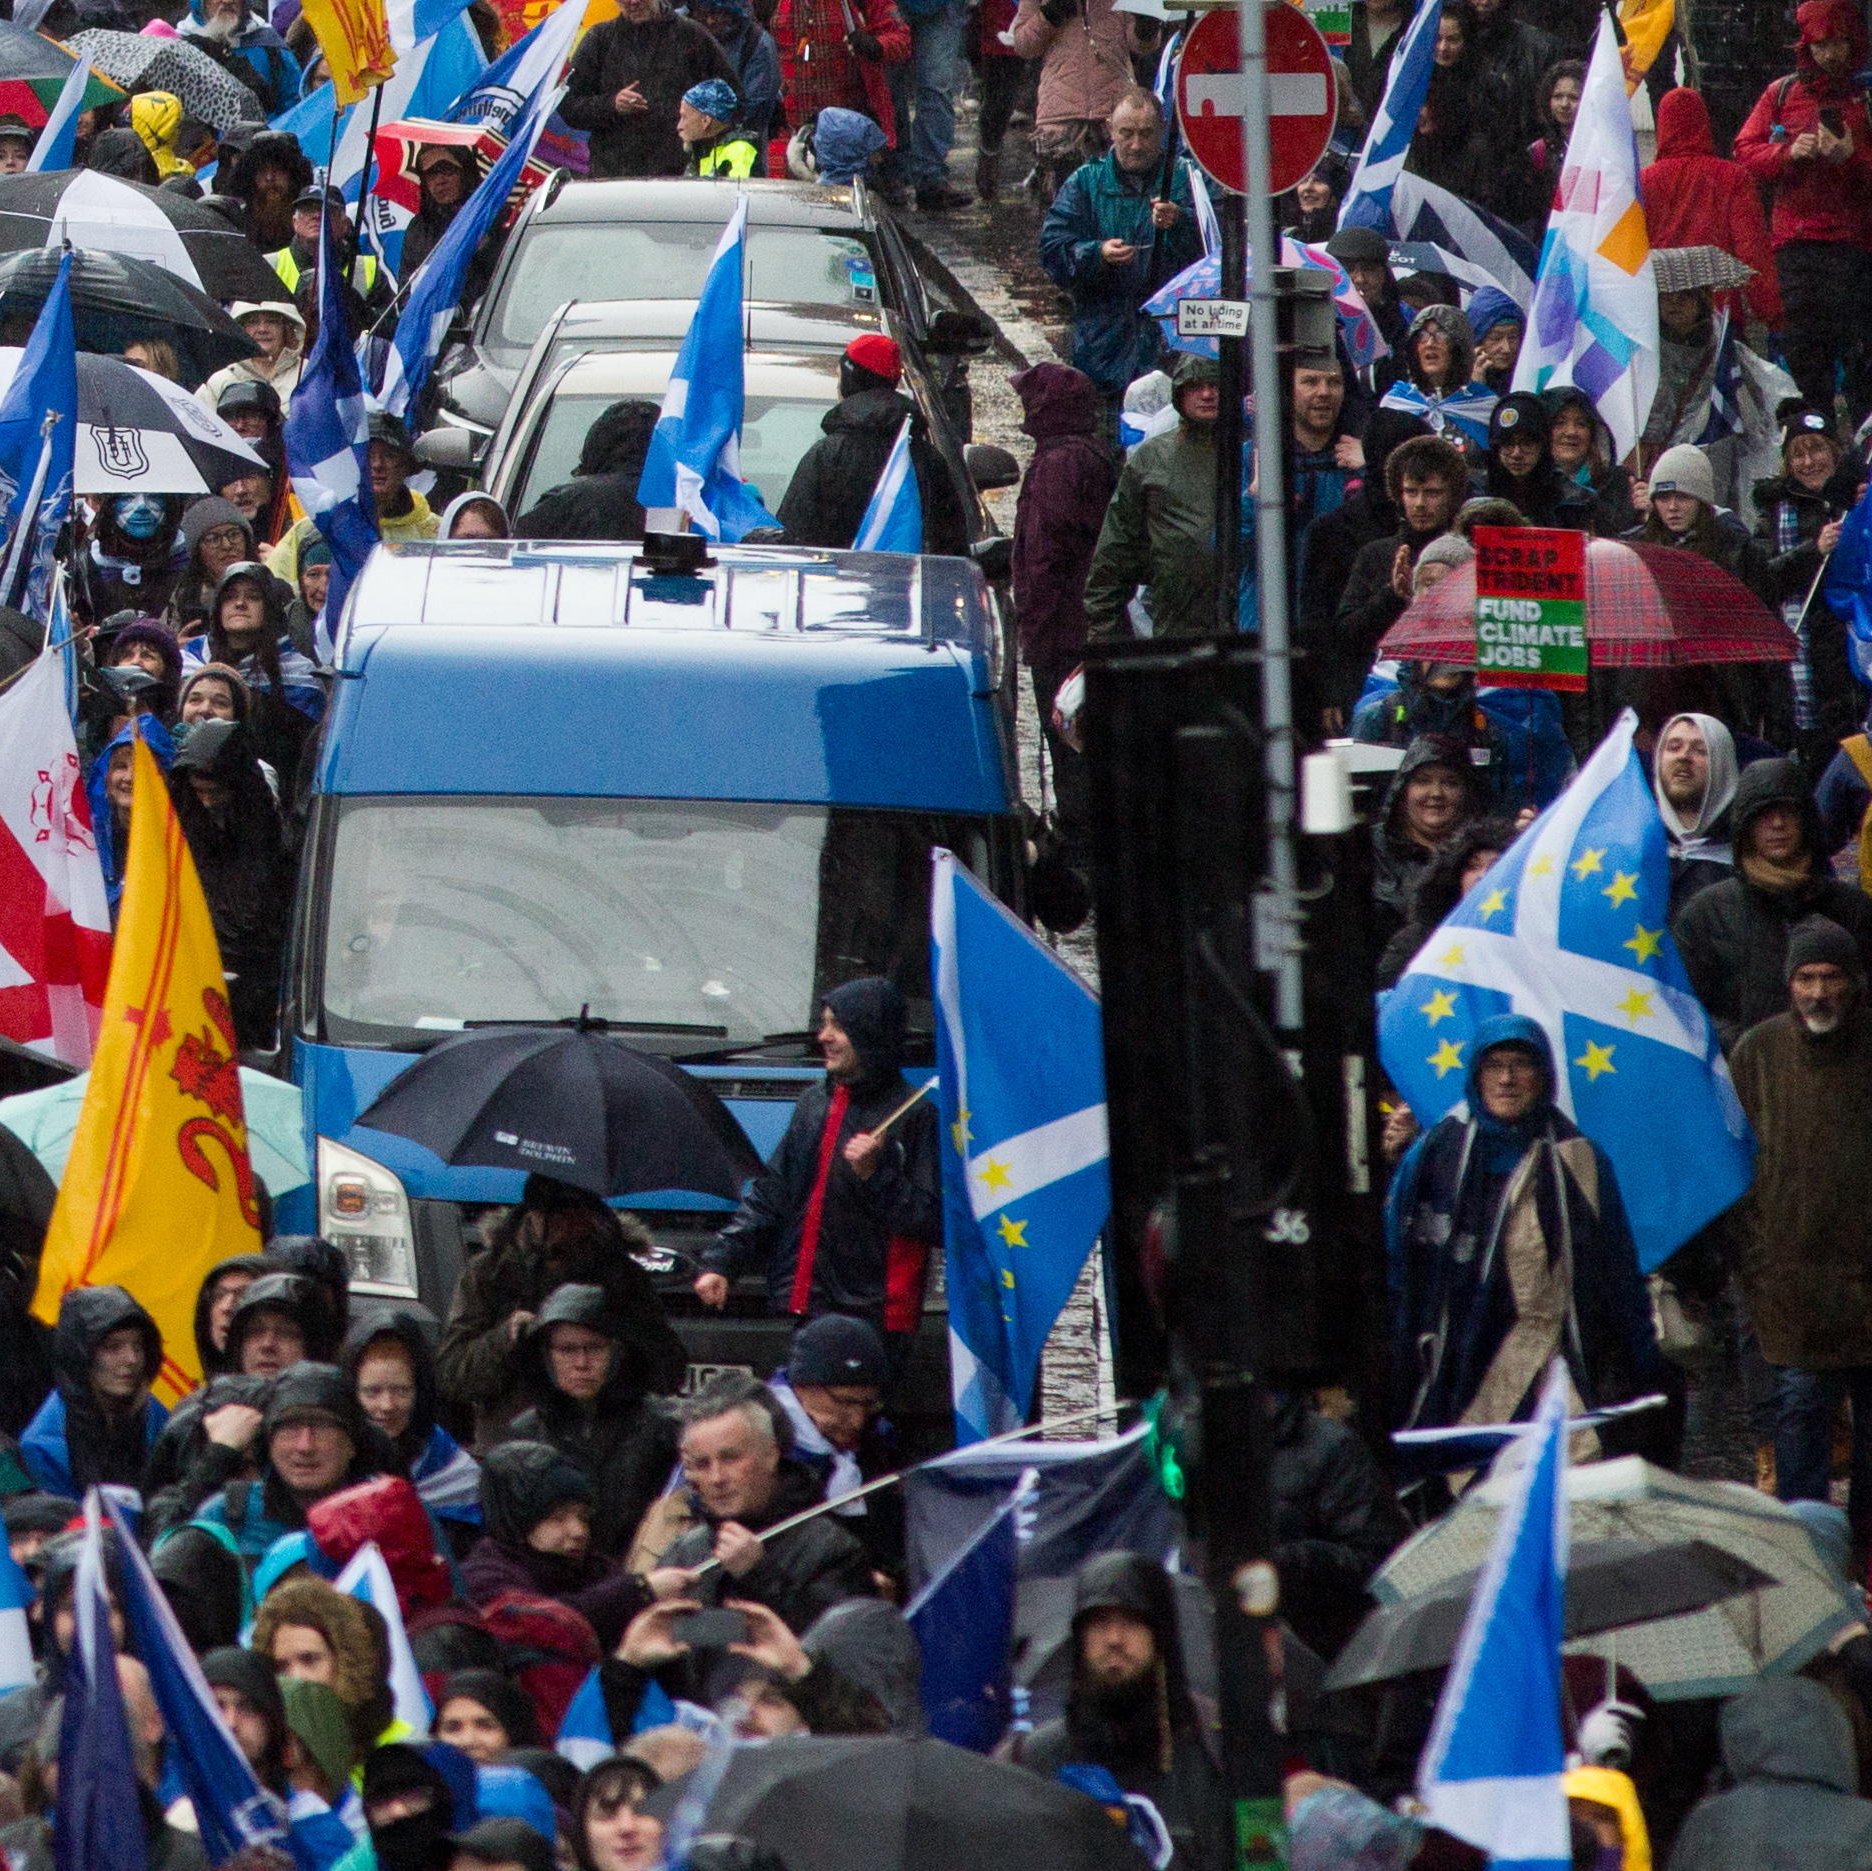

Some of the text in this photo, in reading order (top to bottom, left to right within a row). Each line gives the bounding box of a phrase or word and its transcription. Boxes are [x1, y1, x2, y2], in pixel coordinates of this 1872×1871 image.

[1186, 305, 1204, 316] No
[1184, 320, 1198, 329] at
[1479, 546, 1557, 568] SCRAP
[1479, 570, 1577, 591] TRIDENT
[1479, 598, 1542, 622] FUND
[1480, 622, 1584, 648] CLIMATE
[1479, 647, 1542, 669] JOBS
[520, 1148, 577, 1165] DOLPHIN
